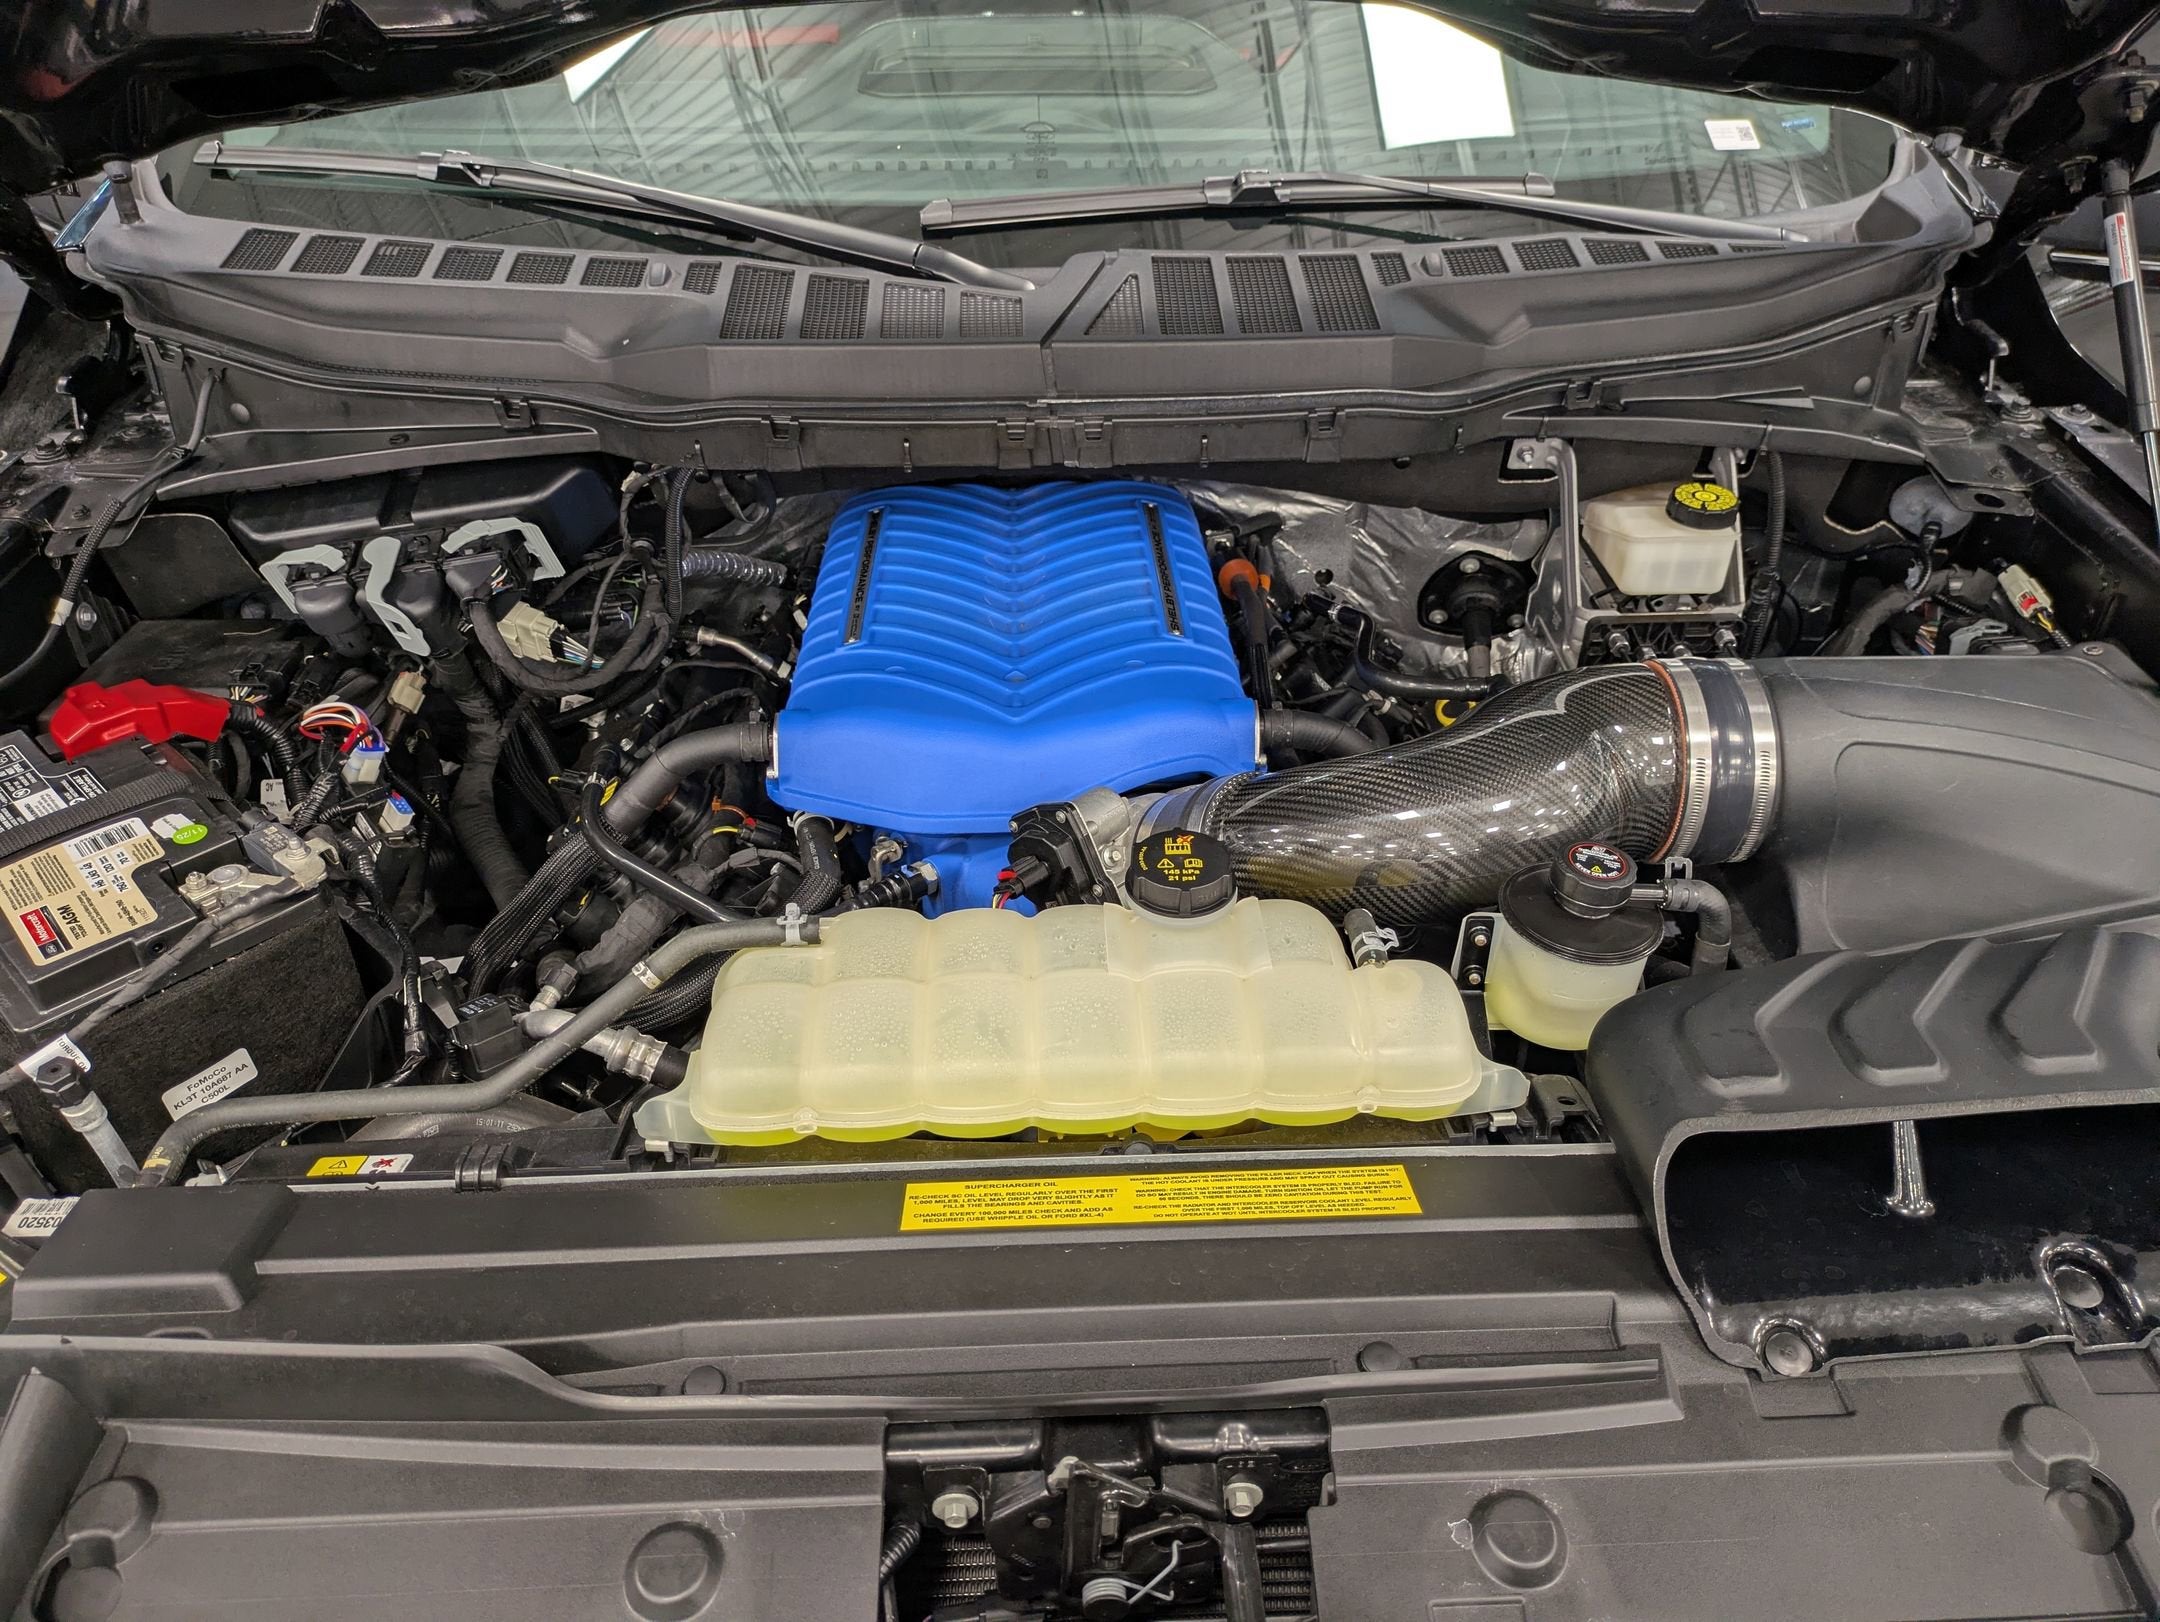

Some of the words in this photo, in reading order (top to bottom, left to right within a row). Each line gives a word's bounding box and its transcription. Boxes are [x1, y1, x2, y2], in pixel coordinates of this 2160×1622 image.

[854, 540, 873, 603] PERFORMANCE
[1152, 530, 1173, 591] PERFORMANCE
[1164, 592, 1179, 630] SHELBY
[82, 861, 93, 870] 48
[102, 862, 115, 872] 120
[119, 856, 130, 864] 70
[94, 878, 106, 888] H6
[56, 903, 80, 926] AGM
[26, 912, 49, 941] Motorcraft
[173, 1092, 198, 1111] KL3T
[200, 1072, 233, 1095] 10A687
[234, 1062, 249, 1075] AA
[187, 1065, 227, 1092] FoMoCo
[201, 1085, 231, 1104] C500L
[18, 1216, 62, 1228] 03520
